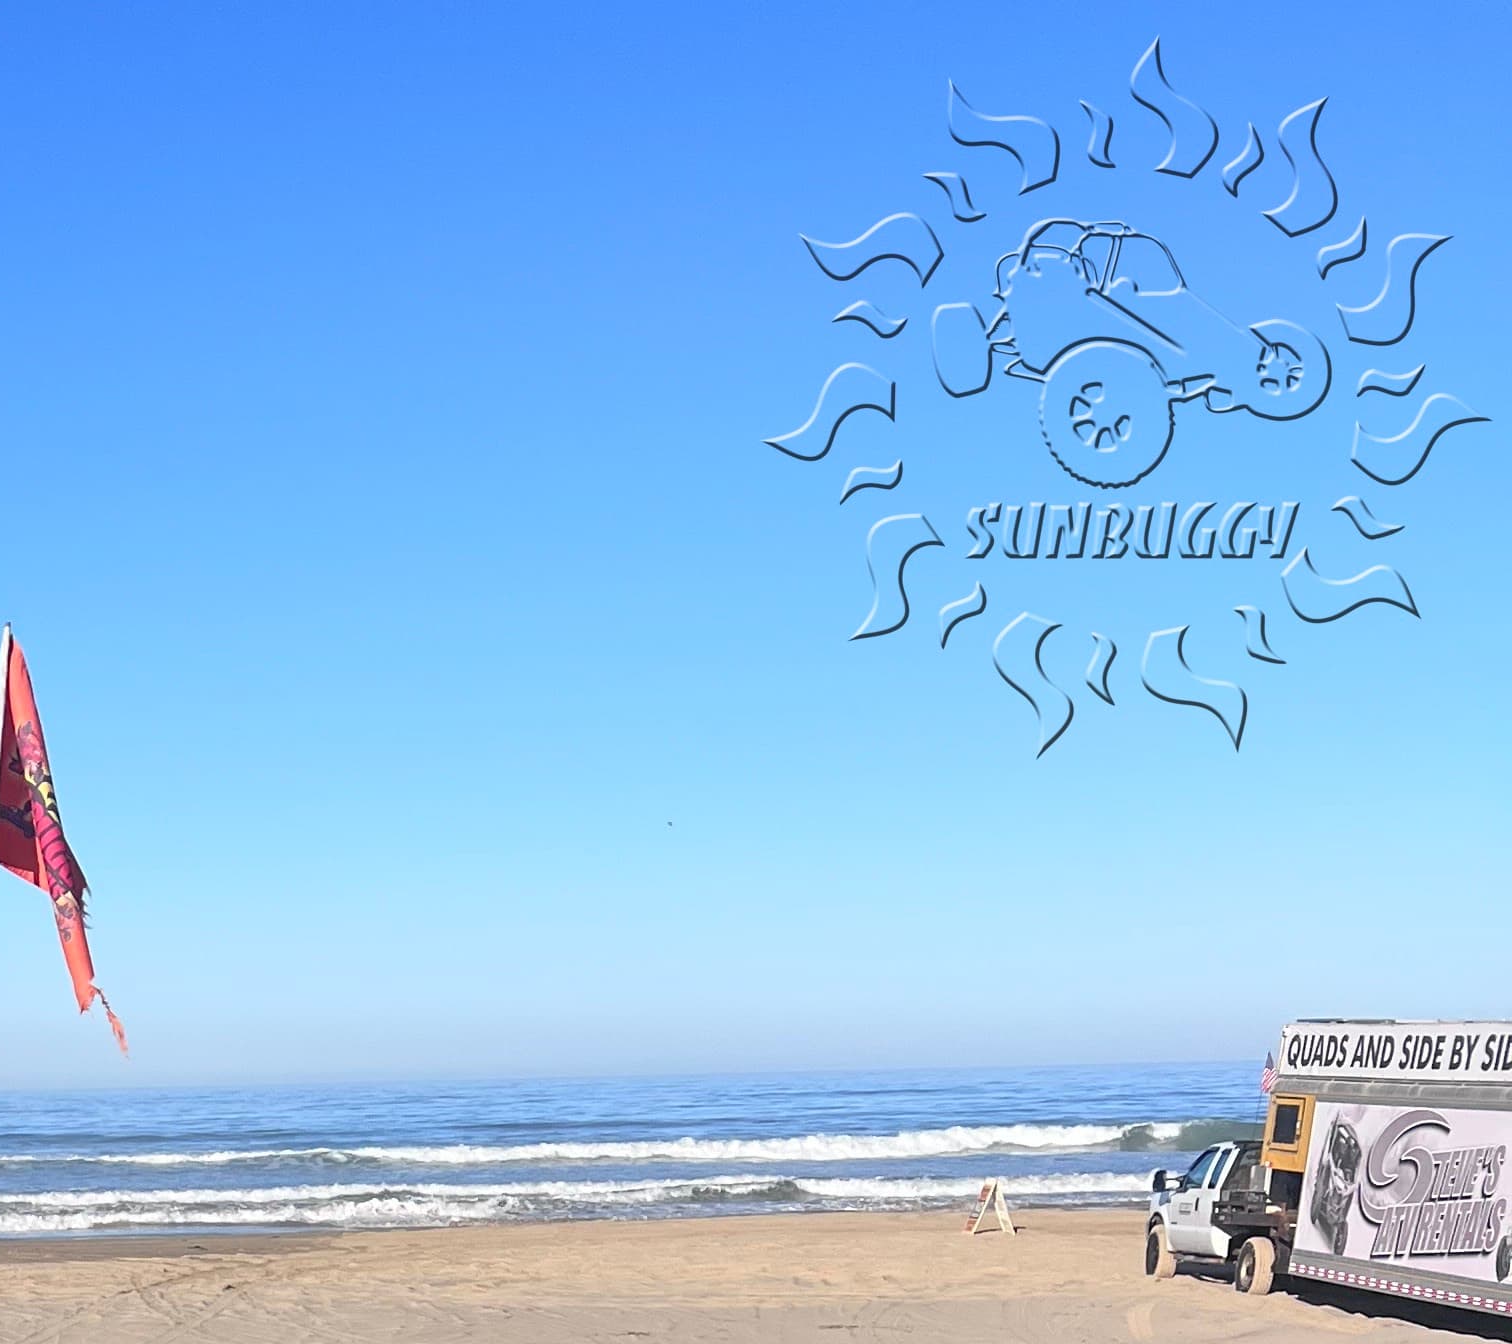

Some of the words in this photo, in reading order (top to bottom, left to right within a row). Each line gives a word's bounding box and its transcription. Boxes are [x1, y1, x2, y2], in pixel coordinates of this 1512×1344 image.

[1288, 1034, 1349, 1069] QUADS
[1350, 1035, 1395, 1068] AND
[1398, 1034, 1447, 1070] SIDE
[1448, 1034, 1480, 1070] BY
[1358, 1109, 1507, 1224] STEVE'S
[1372, 1203, 1422, 1258] ATV
[1411, 1198, 1507, 1256] RENTALS
